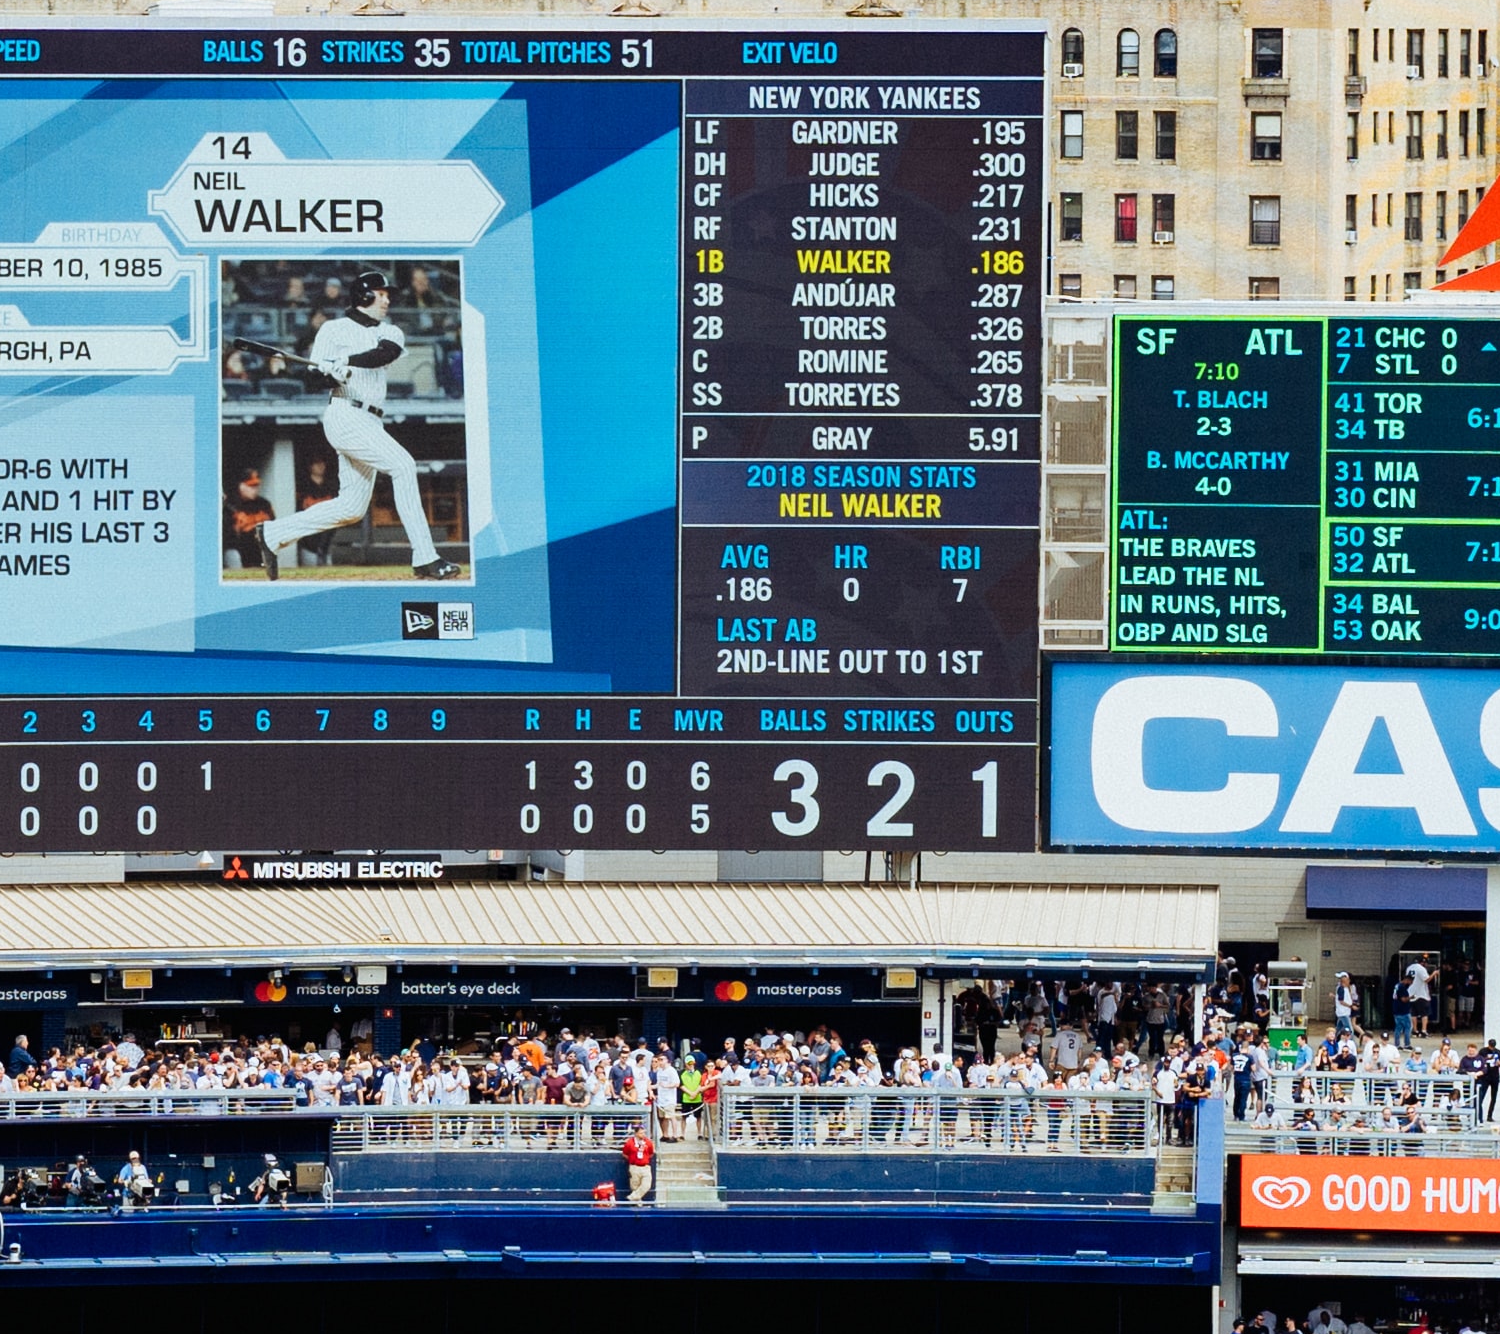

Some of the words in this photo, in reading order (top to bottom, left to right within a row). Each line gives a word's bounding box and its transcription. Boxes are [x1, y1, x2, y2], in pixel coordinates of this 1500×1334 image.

[750, 87, 801, 108] NEW
[809, 87, 870, 108] YORK
[878, 87, 980, 109] YANKEES
[793, 121, 898, 144] GARDNER
[194, 172, 245, 190] NEIL
[195, 199, 383, 232] WALKER
[792, 217, 896, 240] STANTON
[54, 259, 88, 280] 10,
[100, 259, 161, 277] 1985
[60, 342, 91, 360] PA
[785, 383, 900, 406] TORREYES
[1119, 538, 1163, 556] THE
[1171, 539, 1256, 558] BRAVES
[761, 710, 826, 731] BALLS
[844, 710, 934, 731] STRIKES
[956, 711, 1013, 732] OUTS
[254, 862, 350, 880] MITSUBISHI
[358, 858, 447, 878] ELECTRIC
[401, 982, 456, 996] batter's
[459, 985, 485, 997] eye
[489, 982, 521, 995] deck
[756, 982, 842, 1000] masterpass
[1323, 1175, 1410, 1212] GOOD
